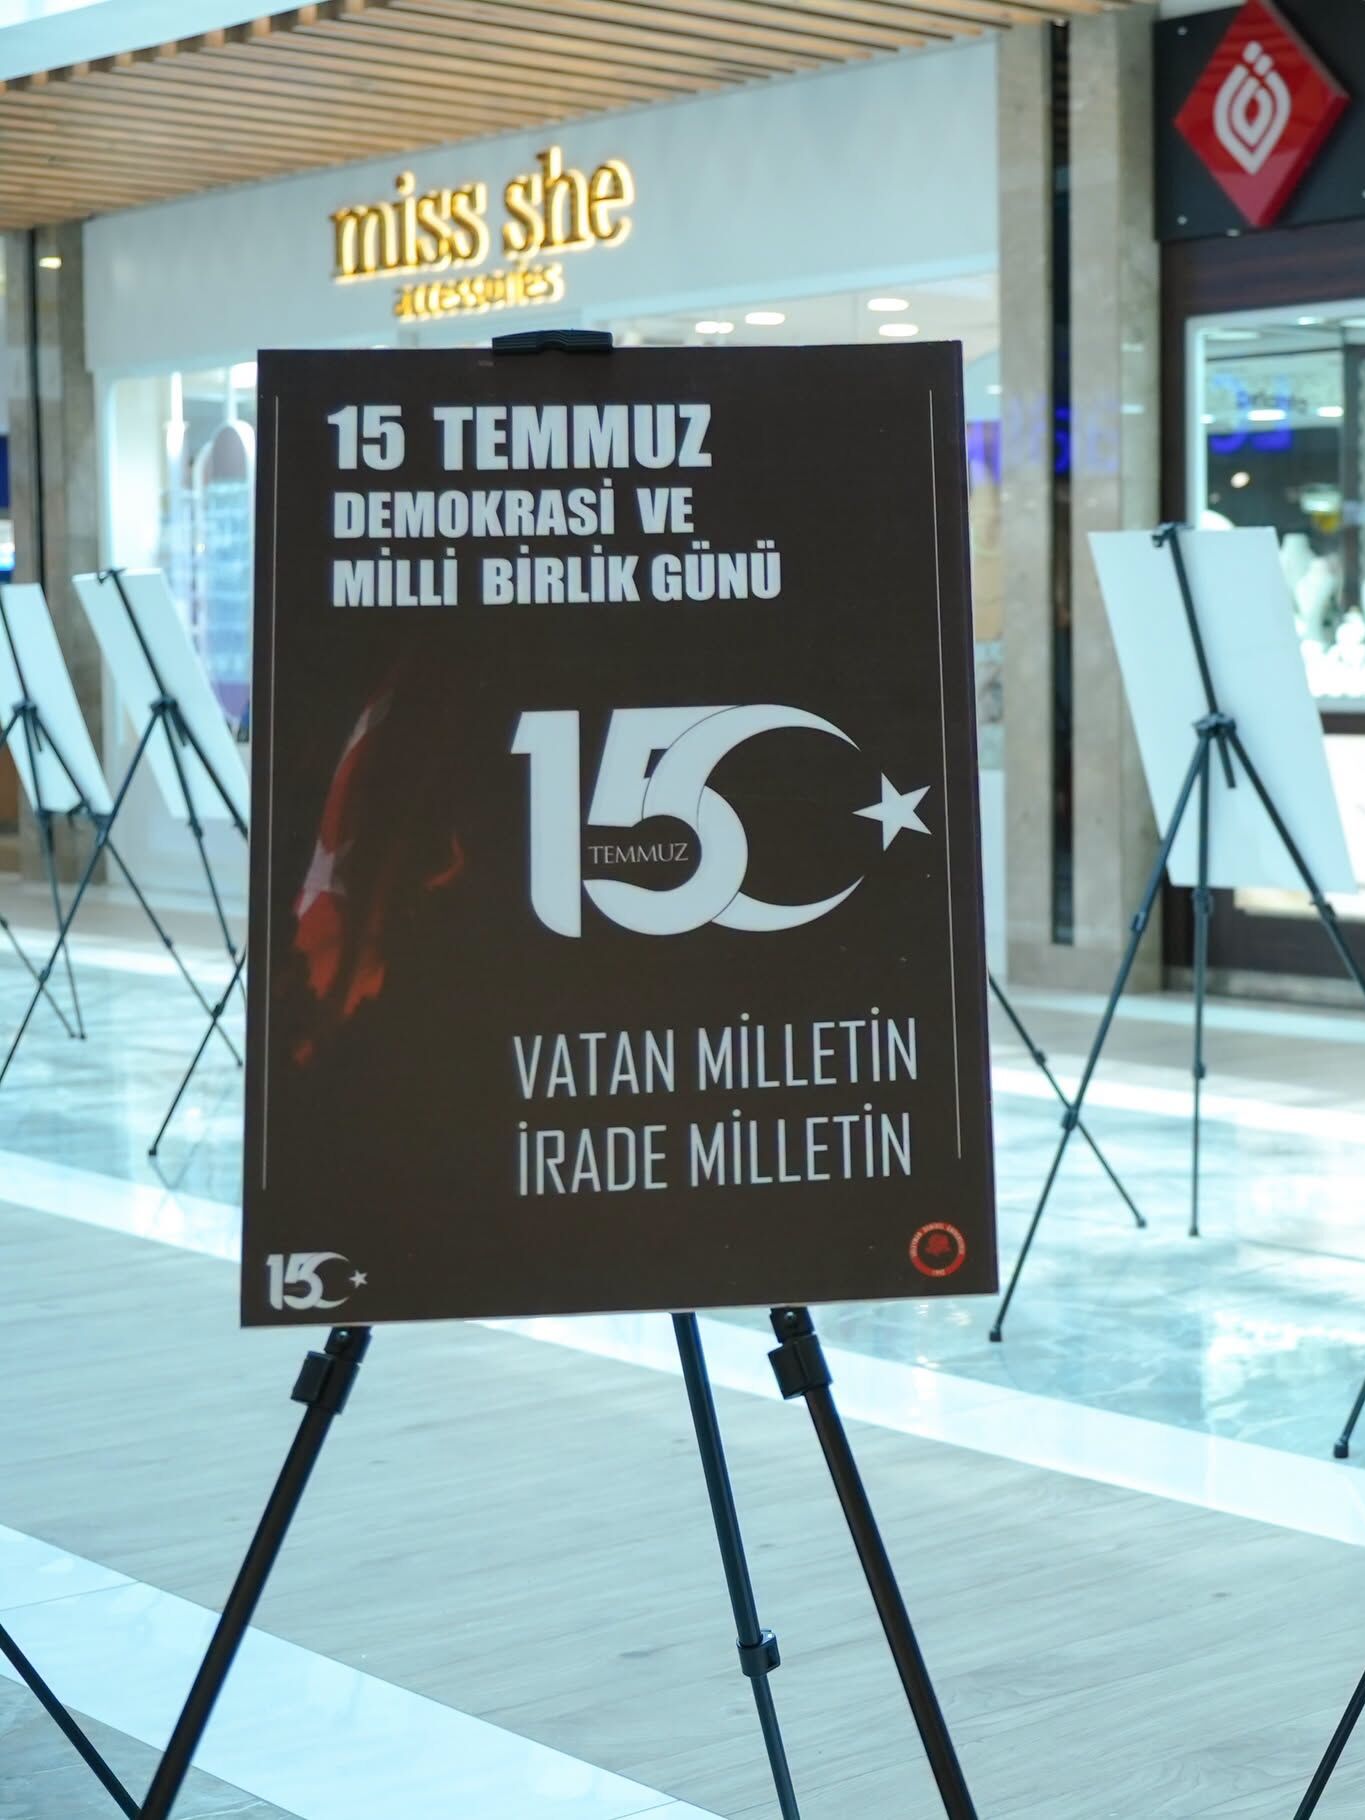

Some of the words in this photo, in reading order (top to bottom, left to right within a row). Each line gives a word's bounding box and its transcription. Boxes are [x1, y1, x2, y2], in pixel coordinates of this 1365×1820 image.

[331, 171, 490, 284] miss
[502, 146, 635, 261] she
[328, 405, 405, 470] 15
[434, 404, 712, 470] TEMMUZ
[333, 478, 615, 539] DEMOKRASİ
[636, 487, 695, 534] VE
[332, 547, 457, 607] MİLLİ
[482, 545, 640, 605] BİRLİK
[651, 540, 782, 601] GÜNÜ
[511, 704, 749, 938] 15
[588, 843, 689, 865] TEMMUZ
[514, 1030, 674, 1099] VATAN
[699, 1007, 917, 1091] MİLLETİN
[519, 1121, 667, 1196] İRADE
[691, 1103, 911, 1187] MİLLETİN
[266, 1252, 324, 1310] 15
